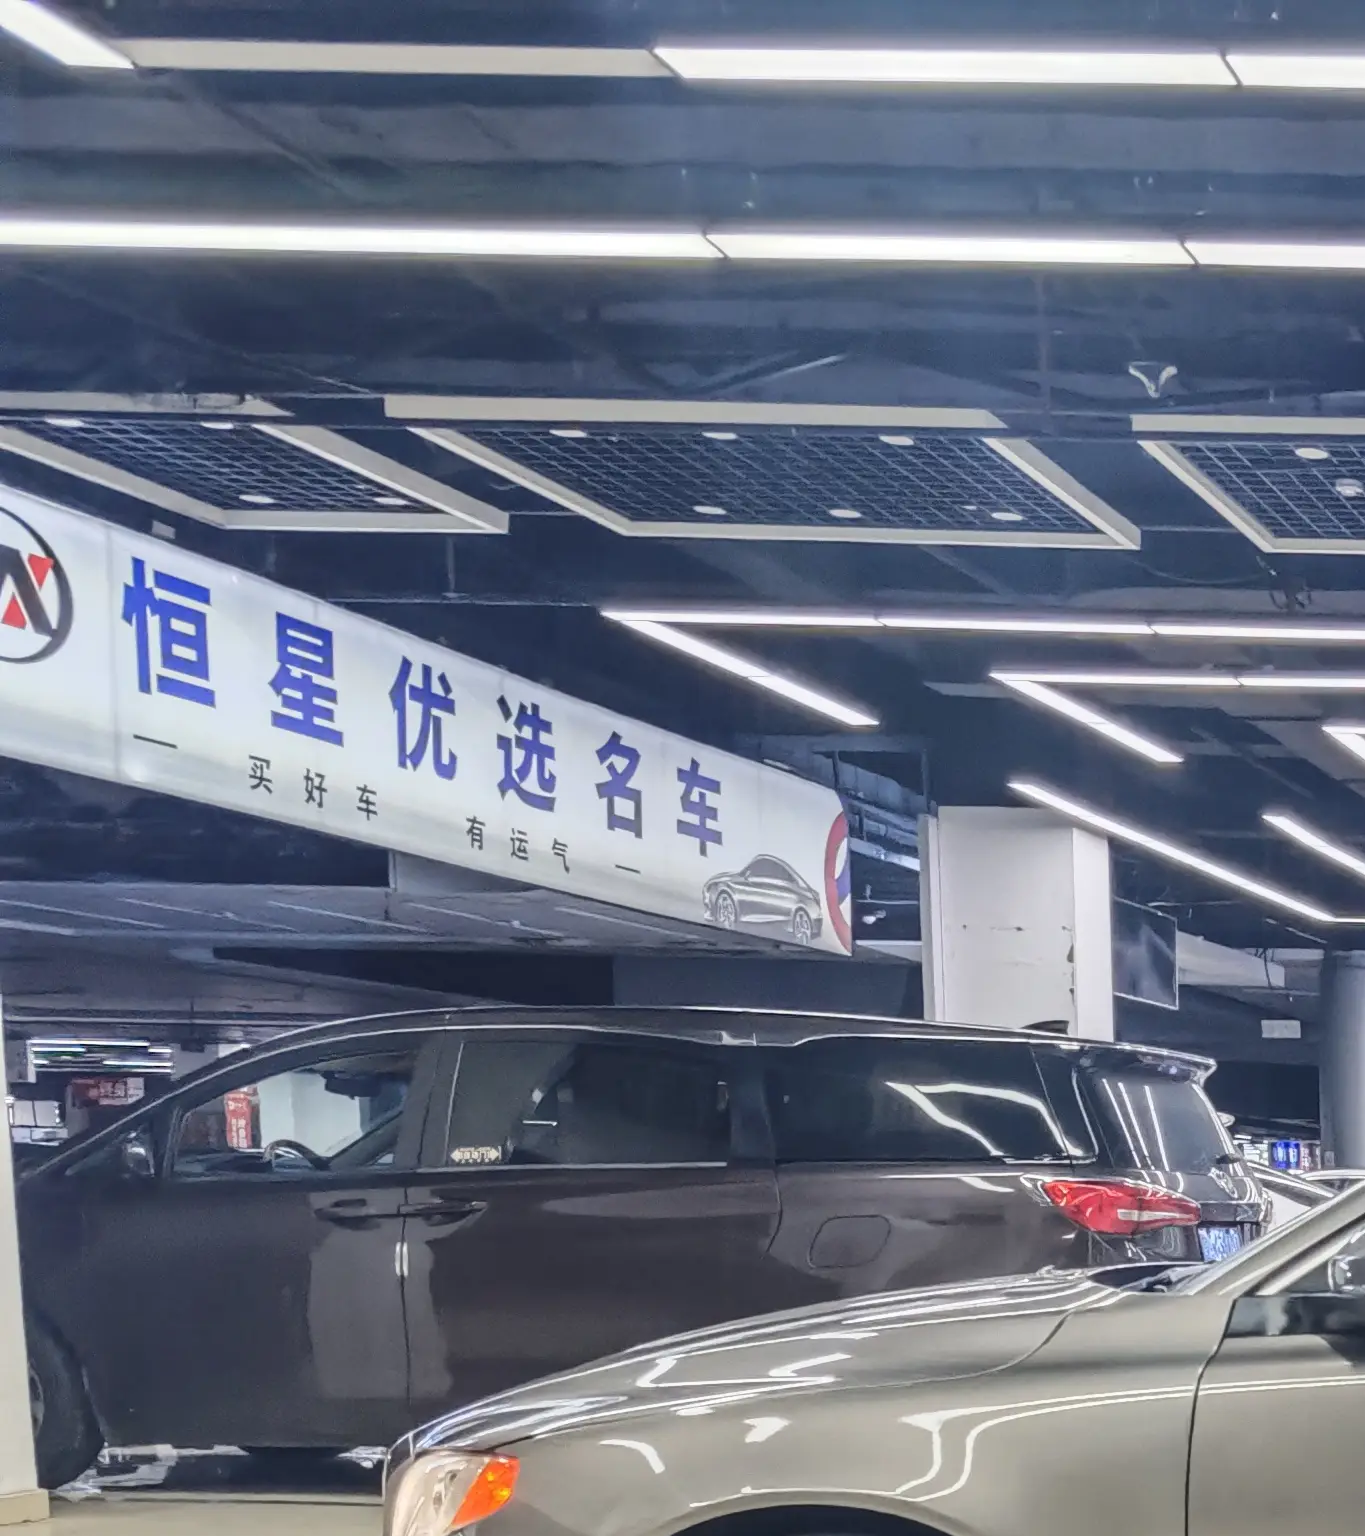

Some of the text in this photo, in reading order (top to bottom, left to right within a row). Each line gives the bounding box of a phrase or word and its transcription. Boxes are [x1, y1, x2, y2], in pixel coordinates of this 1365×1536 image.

[122, 556, 723, 857] 恒星优选名车
[249, 754, 570, 873] 买好车 有运气
